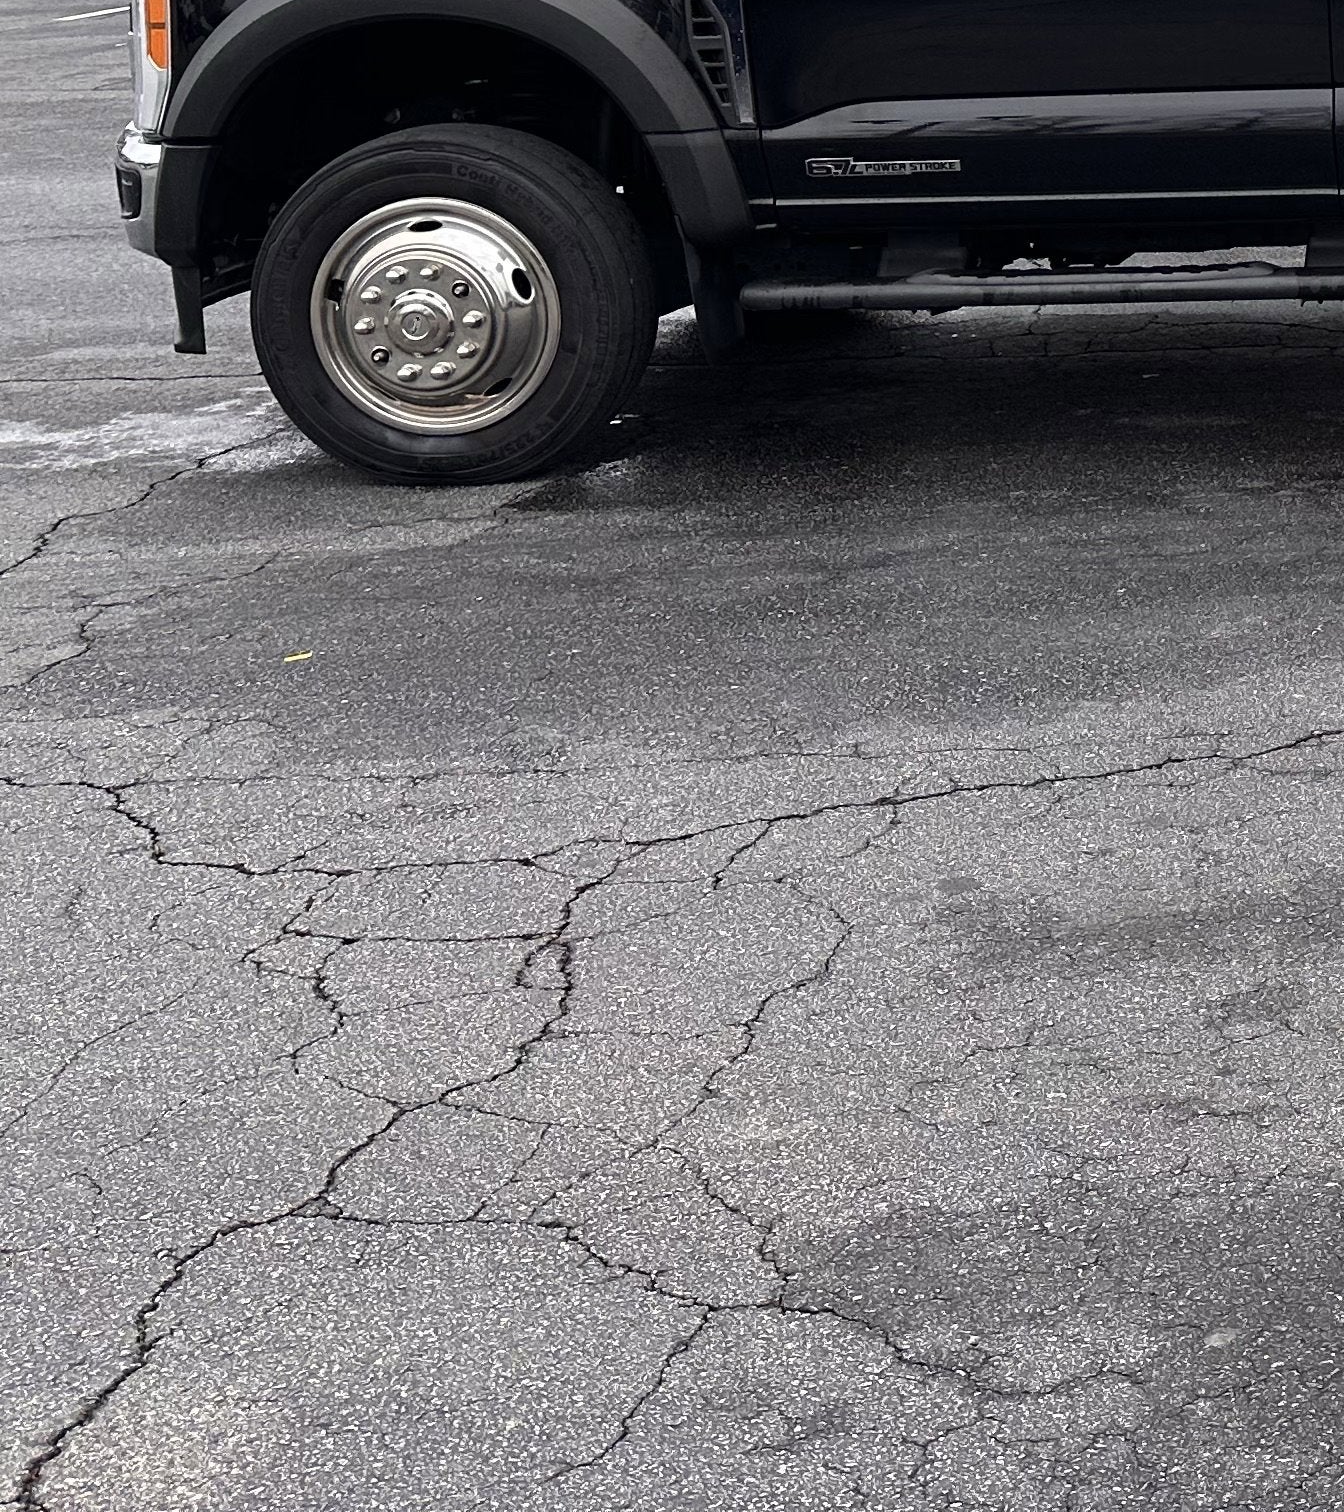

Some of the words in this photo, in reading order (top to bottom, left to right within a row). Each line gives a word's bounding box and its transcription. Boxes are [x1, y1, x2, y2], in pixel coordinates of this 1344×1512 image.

[805, 157, 864, 178] 6.7L
[865, 162, 907, 173] POWER
[909, 161, 956, 172] STROKE
